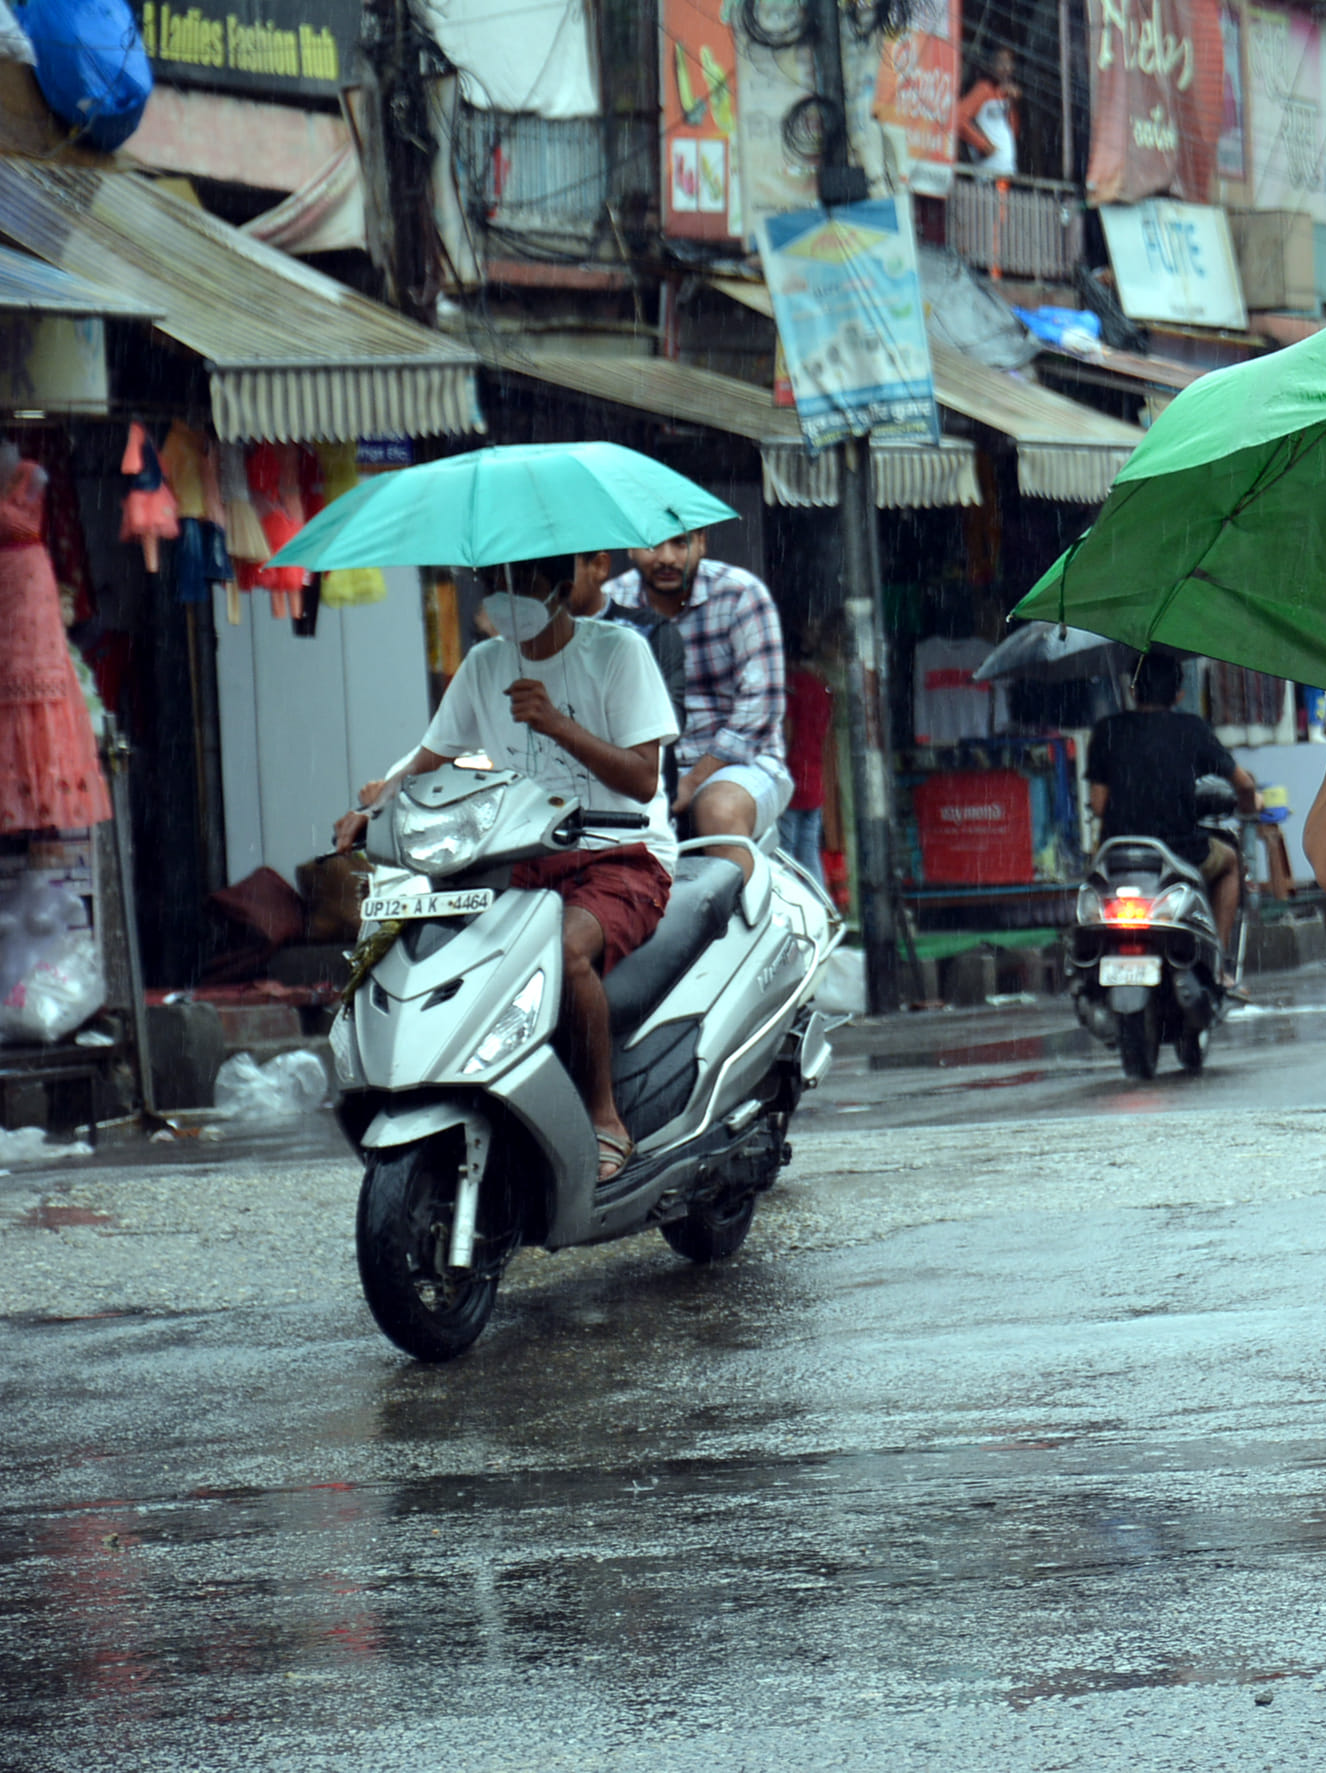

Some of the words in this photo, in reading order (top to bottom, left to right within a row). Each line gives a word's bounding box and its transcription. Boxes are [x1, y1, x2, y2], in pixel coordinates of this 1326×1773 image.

[160, 2, 225, 68] Ladies
[226, 12, 298, 77] Fashion
[299, 22, 338, 81] Hub
[364, 900, 400, 917] UP12
[453, 893, 488, 910] 4464
